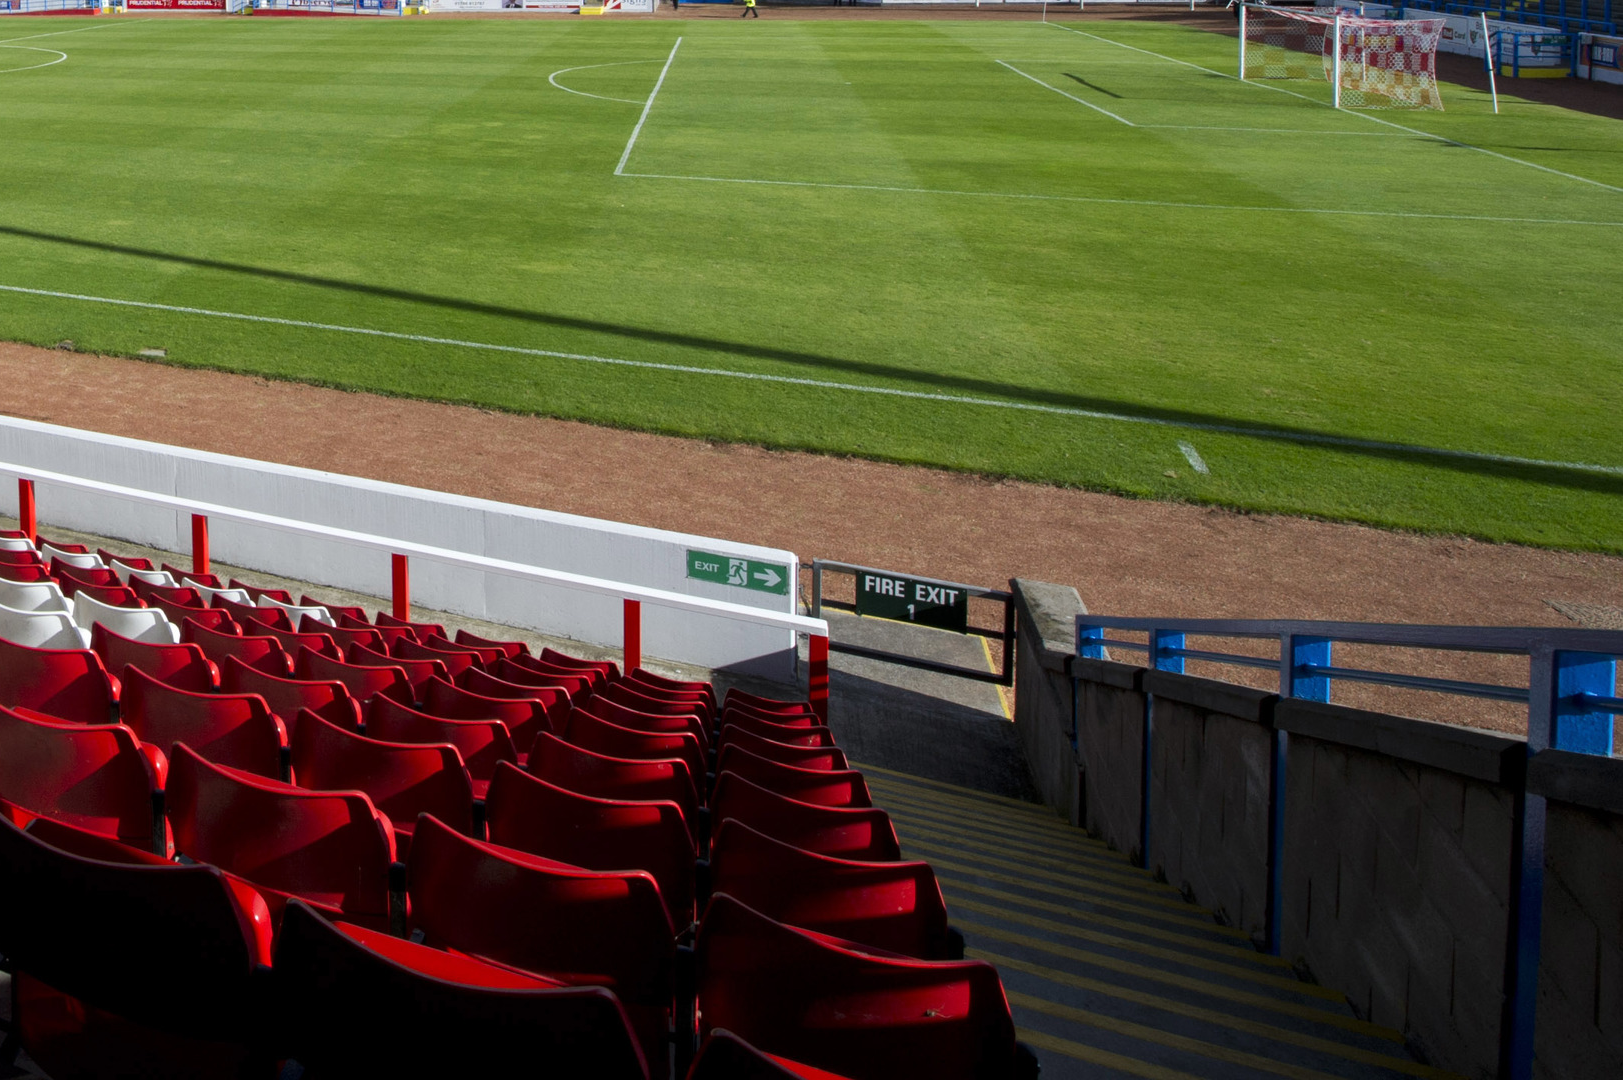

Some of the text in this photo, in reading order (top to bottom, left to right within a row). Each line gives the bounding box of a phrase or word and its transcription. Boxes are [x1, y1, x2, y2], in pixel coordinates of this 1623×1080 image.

[694, 560, 720, 573] EXIT
[865, 575, 958, 606] FIRE EXIT
[907, 604, 915, 620] 1
